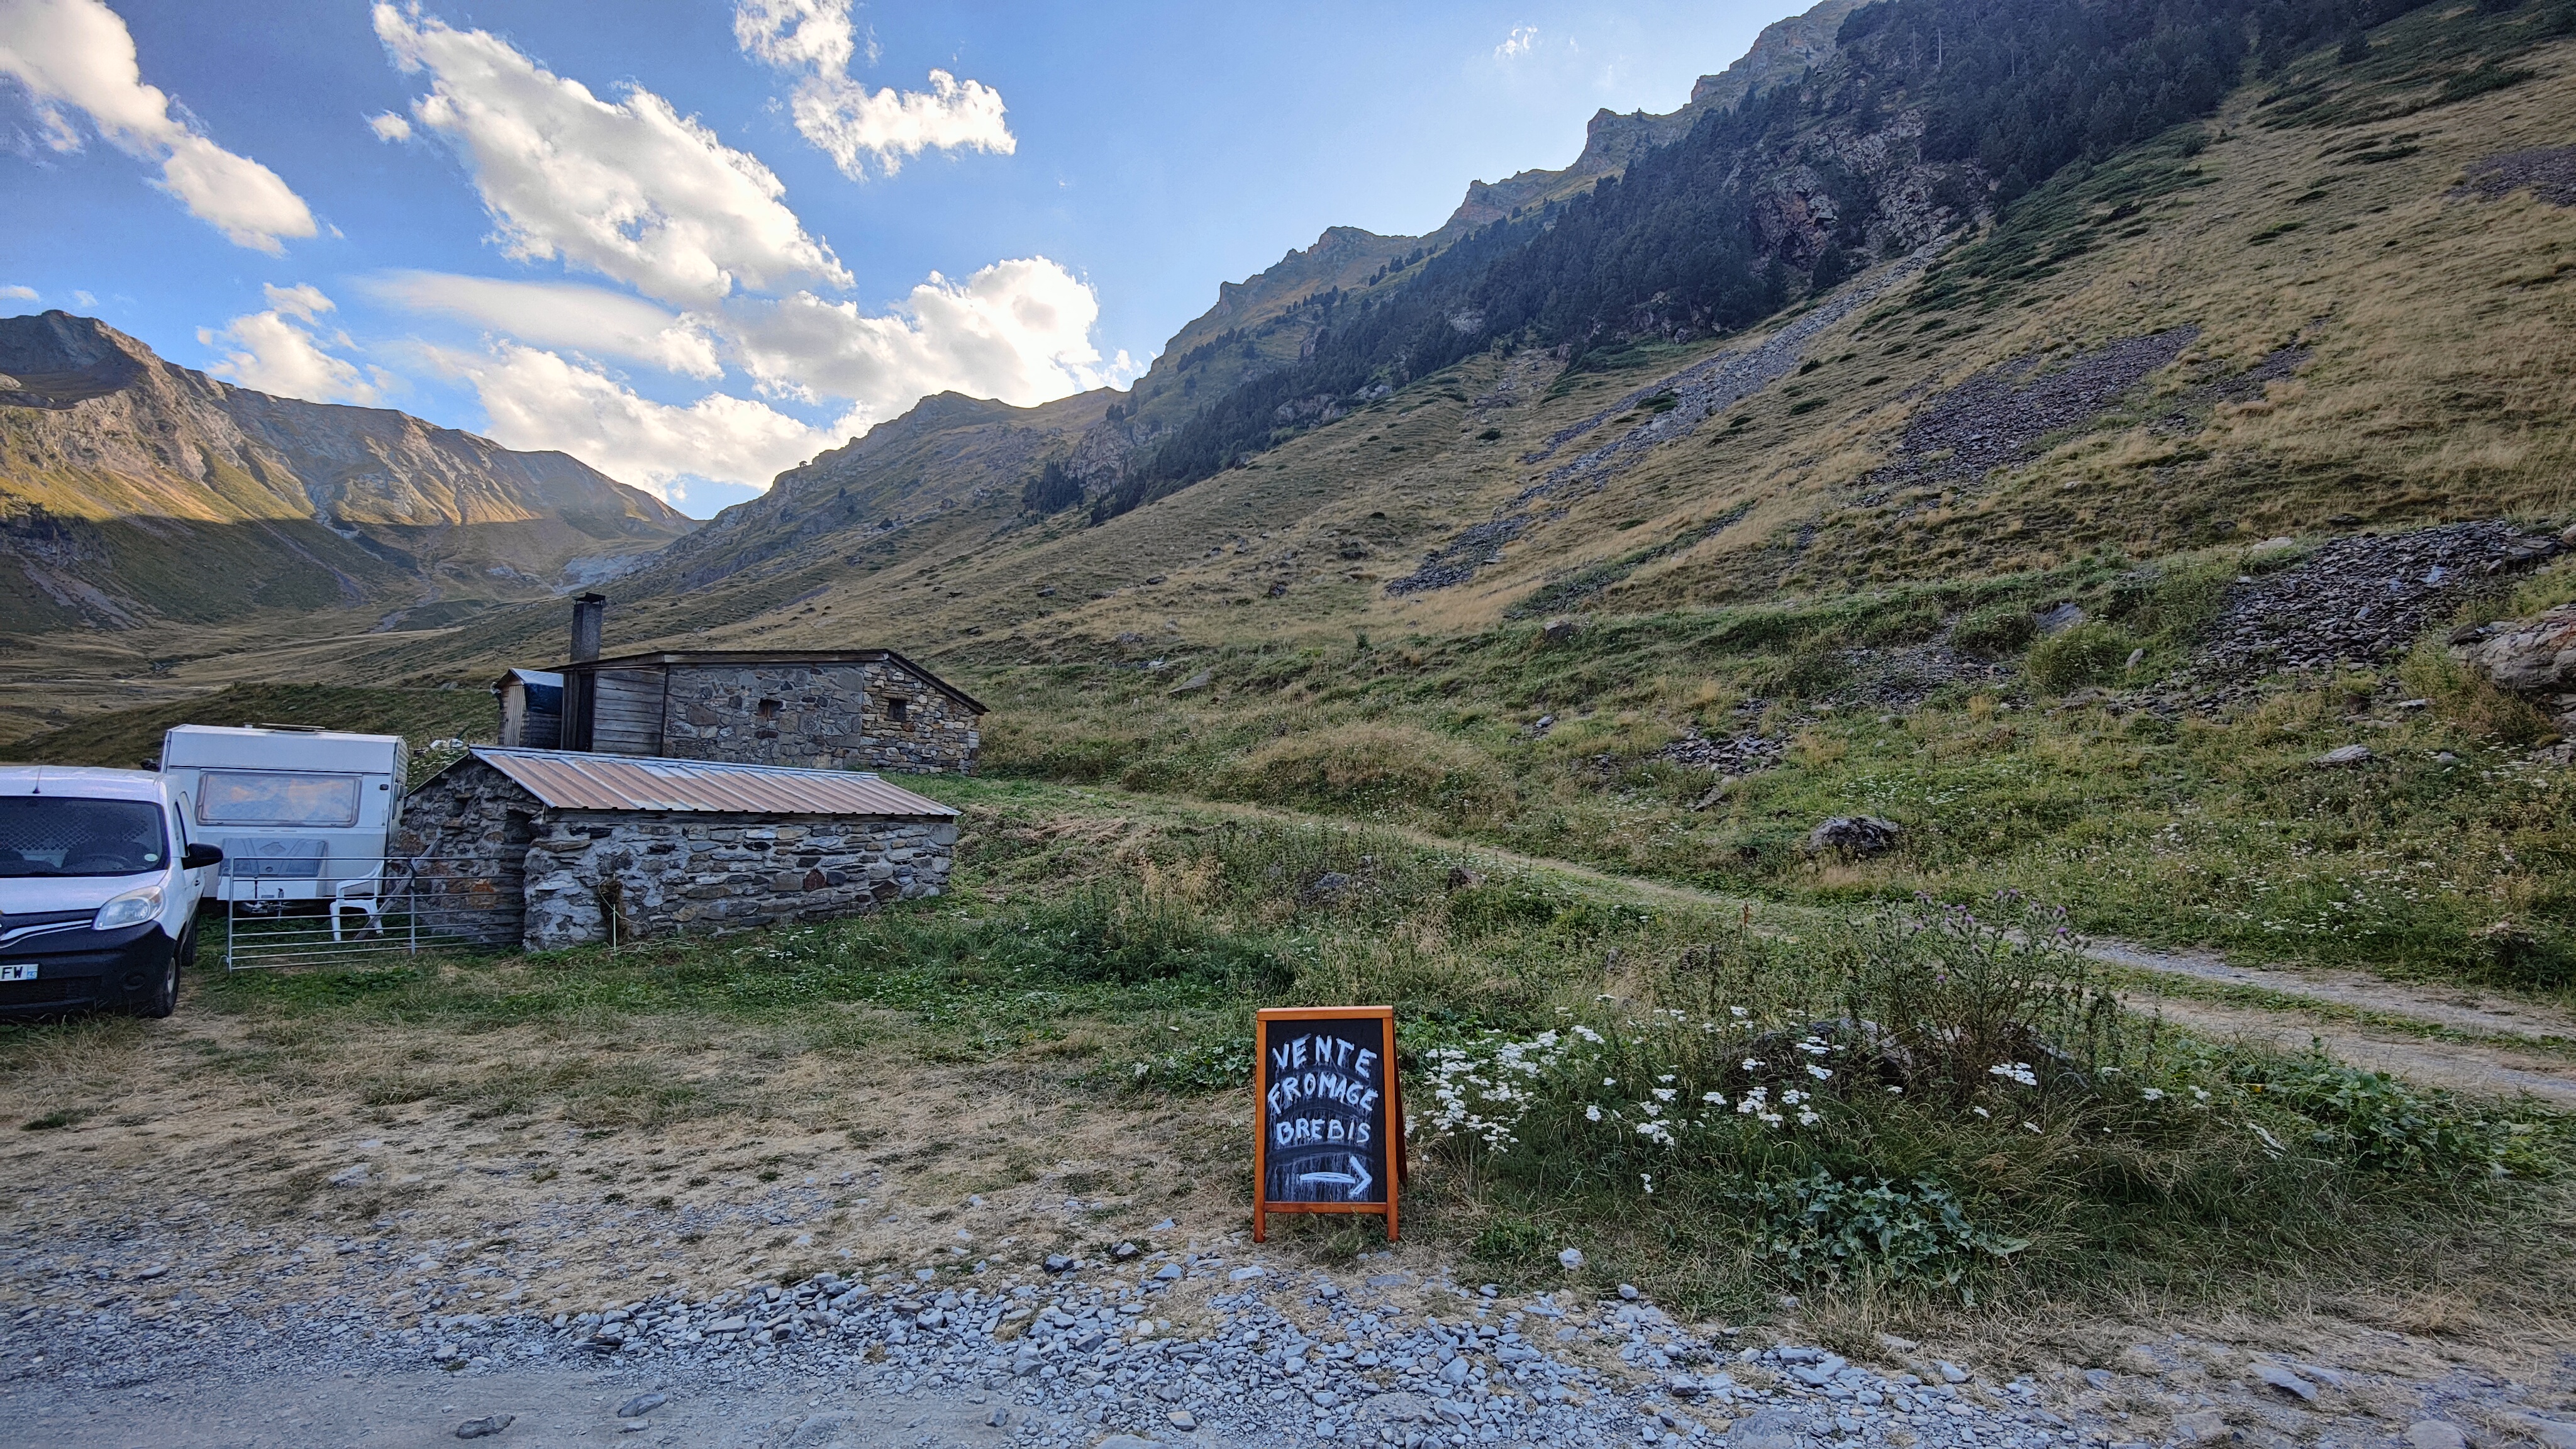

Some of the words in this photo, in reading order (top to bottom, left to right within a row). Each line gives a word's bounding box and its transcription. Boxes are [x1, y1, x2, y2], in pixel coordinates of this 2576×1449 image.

[1273, 1033, 1377, 1077] VENTE
[1267, 1073, 1379, 1114] FROMAGE
[1276, 1118, 1371, 1145] BREBIS
